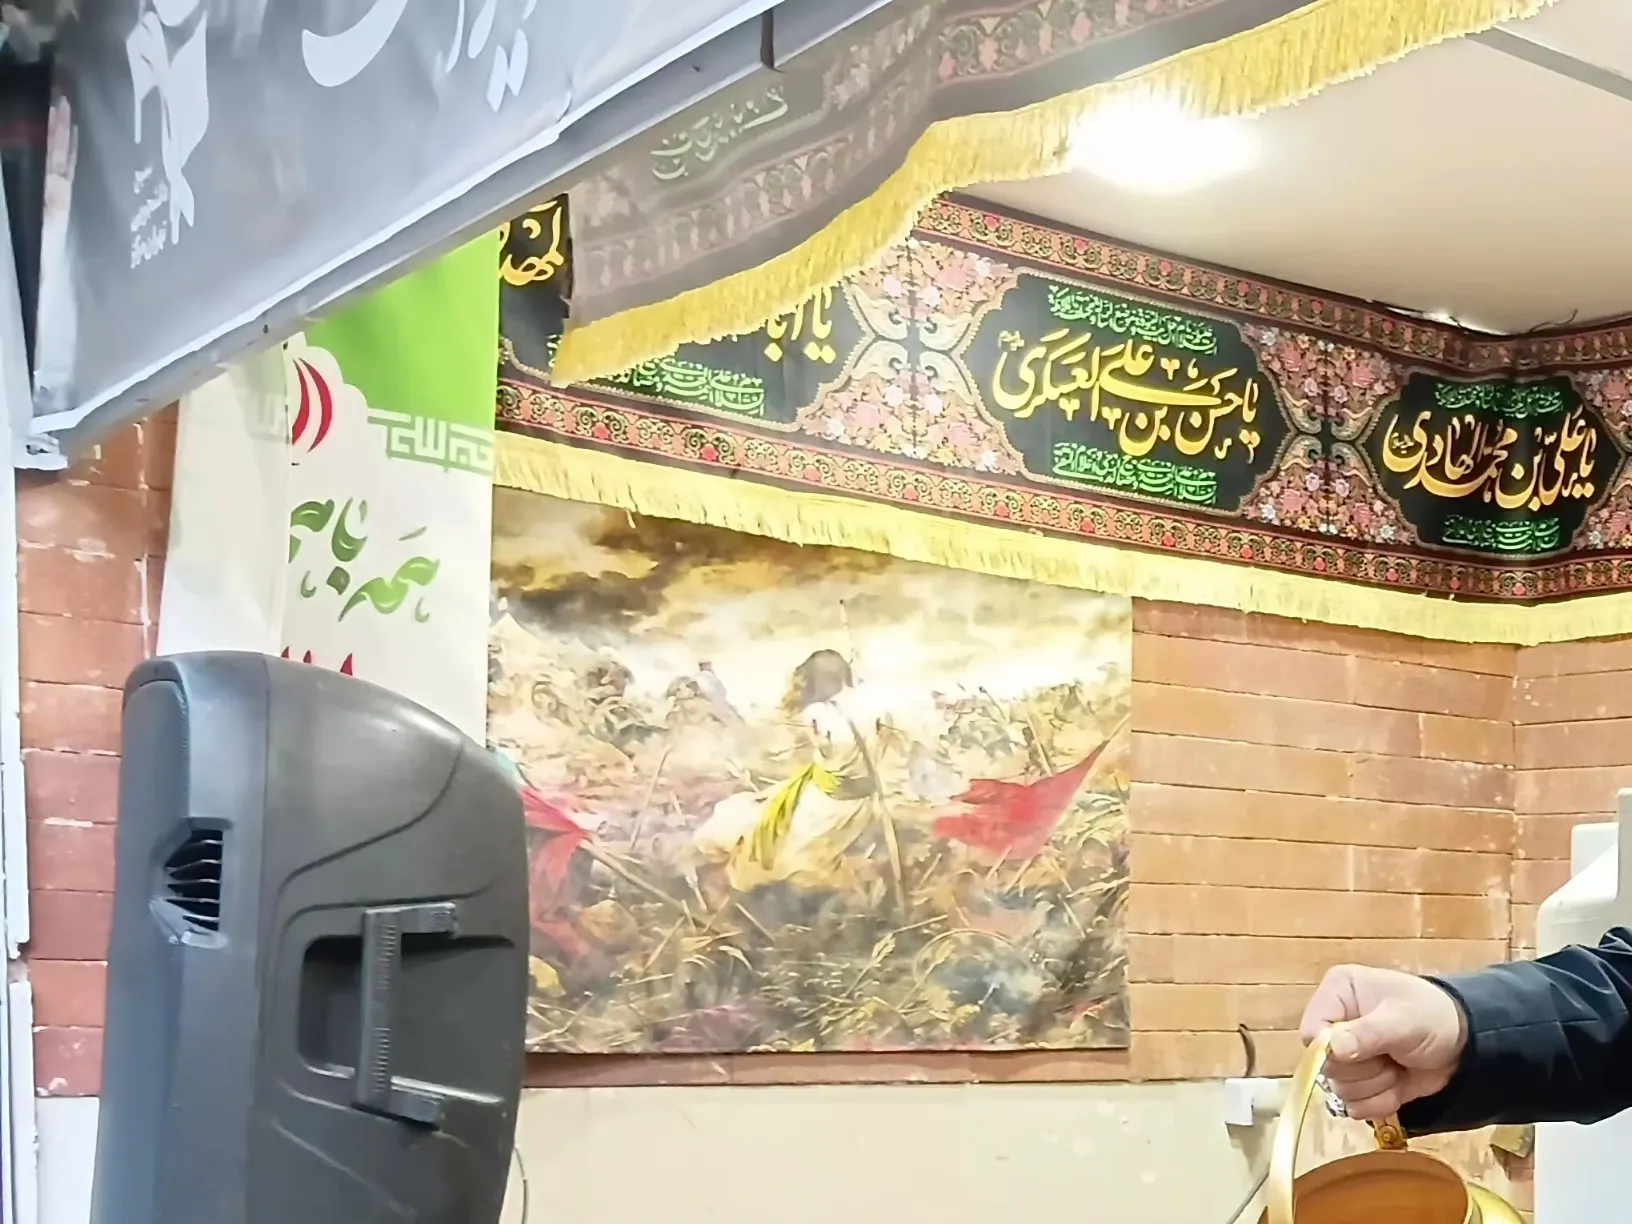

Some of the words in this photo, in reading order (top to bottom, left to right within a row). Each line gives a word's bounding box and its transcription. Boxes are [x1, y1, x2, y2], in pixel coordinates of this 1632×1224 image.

[1119, 405, 1171, 456] بن
[1239, 378, 1261, 447] یا
[1495, 448, 1544, 511] بن
[1571, 428, 1597, 499] یا
